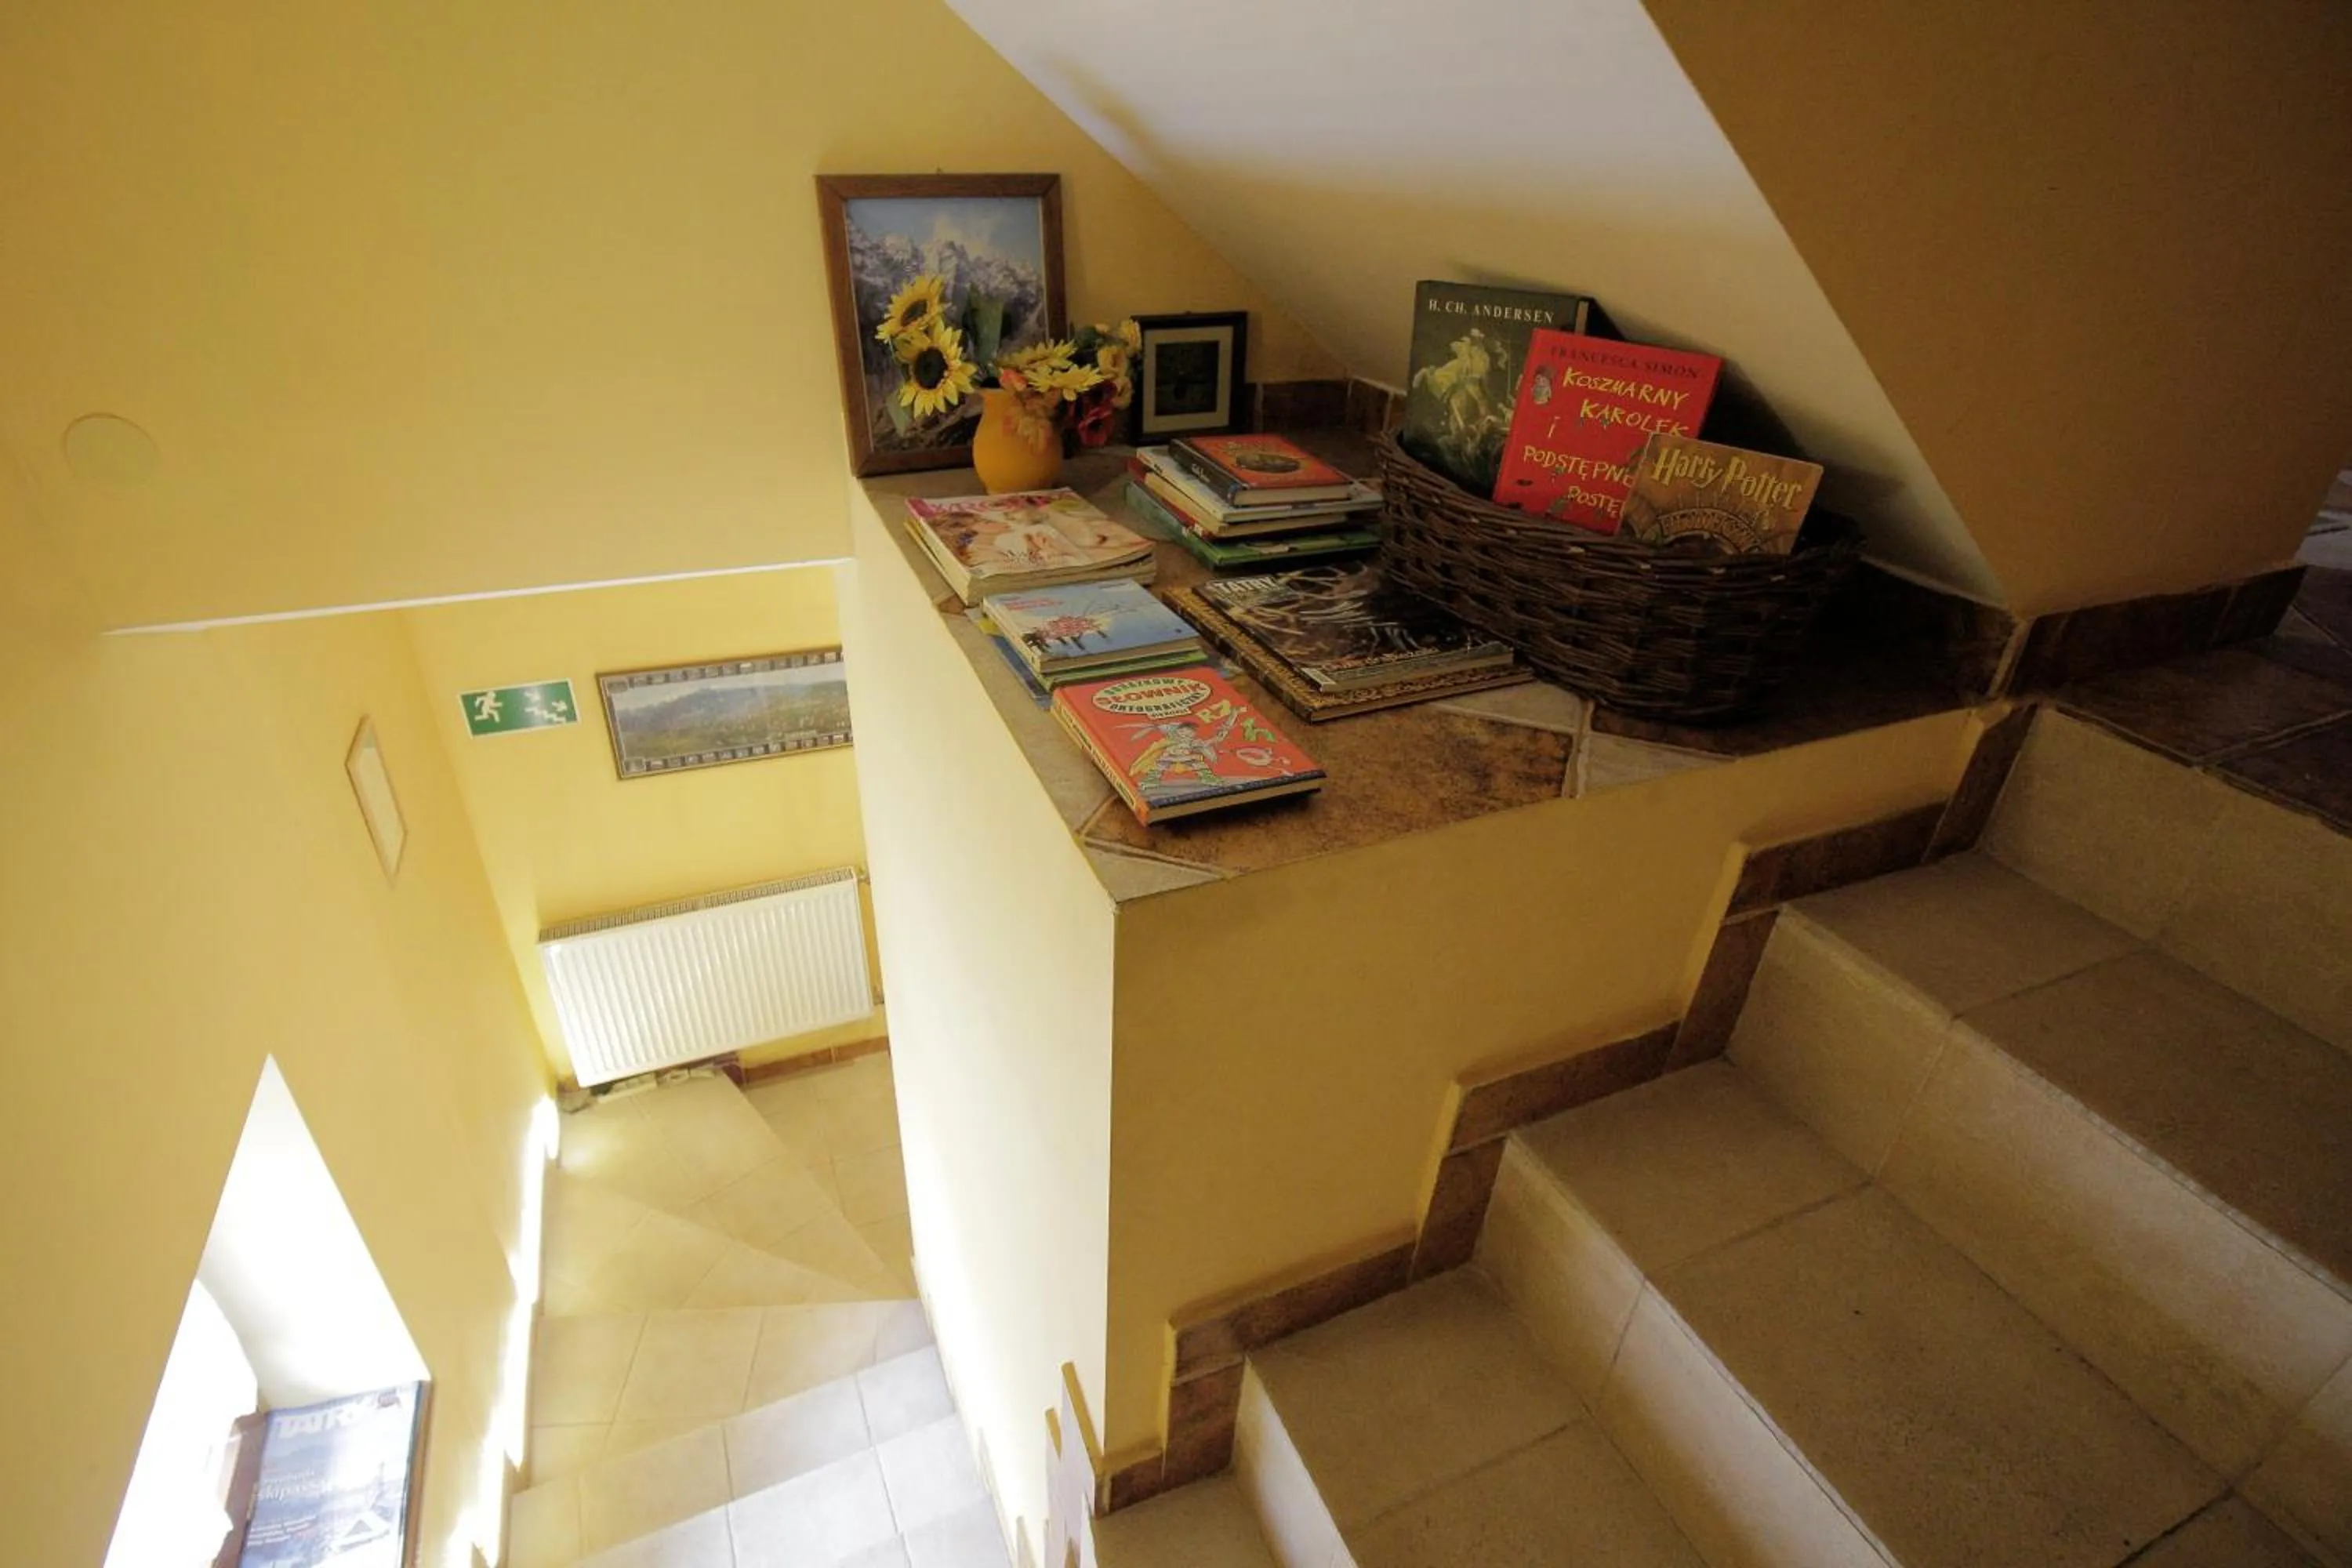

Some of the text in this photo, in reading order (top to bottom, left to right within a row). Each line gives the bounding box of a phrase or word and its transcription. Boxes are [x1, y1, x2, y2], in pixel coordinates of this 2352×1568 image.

[1428, 298, 1554, 324] H. CH. ANDERSEN
[1644, 360, 1700, 379] SIMON
[1563, 366, 1690, 411] KOSZMARNY
[1581, 398, 1689, 437] KAROLEK
[1650, 446, 1802, 510] Harry Potter
[1567, 485, 1625, 520] POSTĘ
[1213, 576, 1276, 594] TATRY
[1095, 682, 1207, 705] SŁOWNIK
